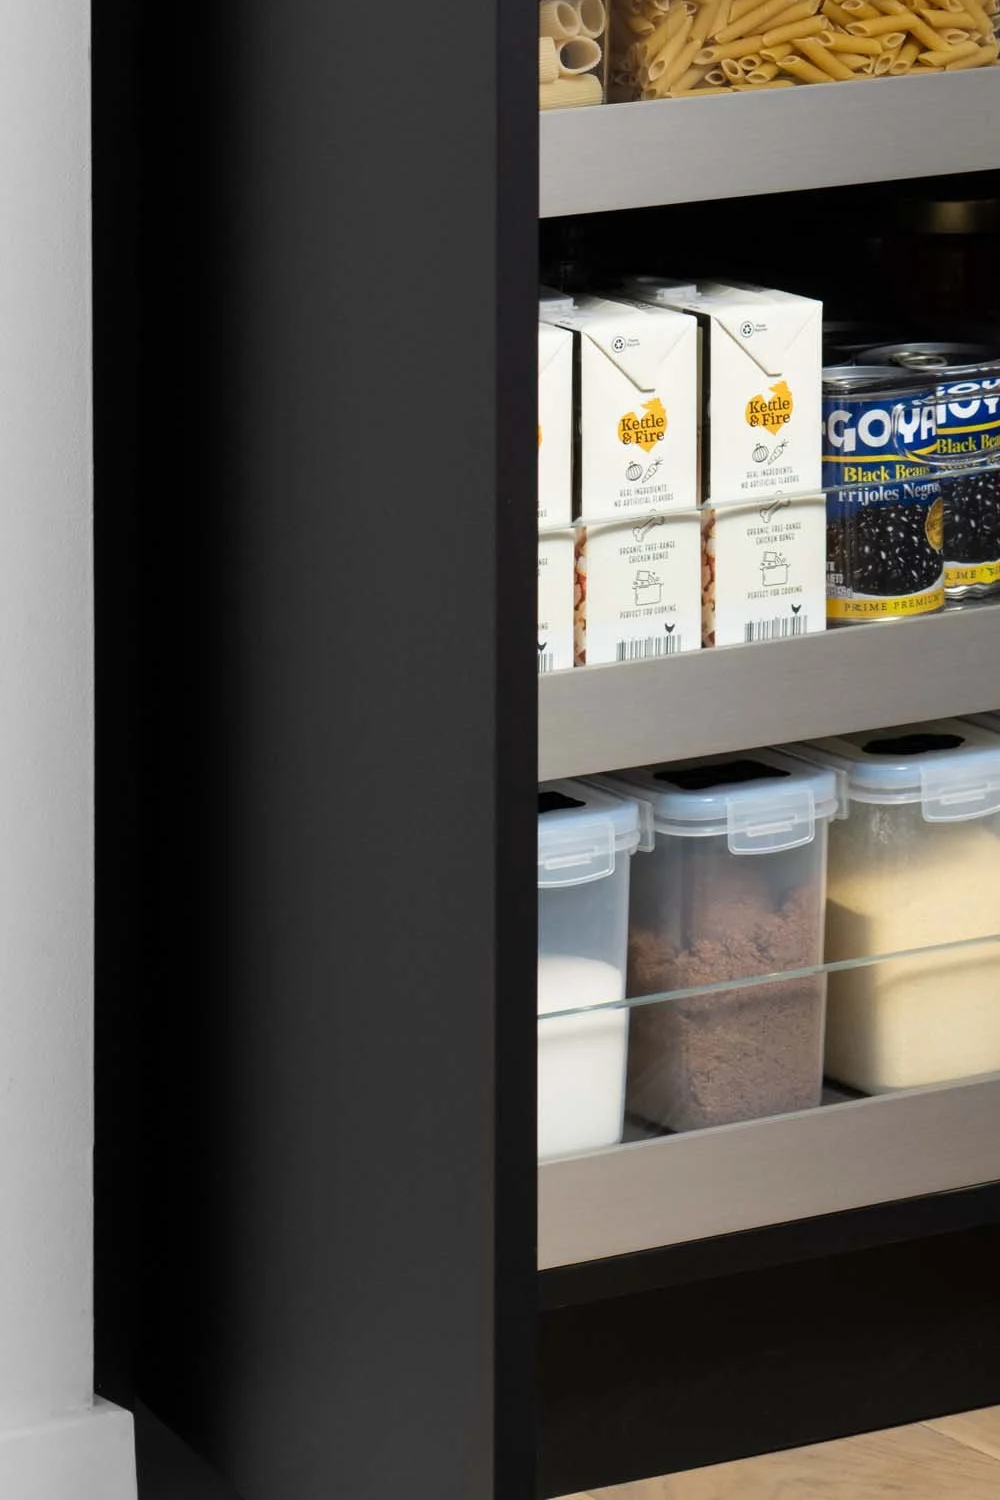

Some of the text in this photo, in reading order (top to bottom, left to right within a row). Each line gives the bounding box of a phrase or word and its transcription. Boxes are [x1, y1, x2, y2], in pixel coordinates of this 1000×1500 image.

[749, 396, 791, 414] Kettle
[621, 414, 664, 431] Kettle
[750, 412, 791, 428] & Fire
[828, 404, 937, 452] GOYA
[622, 429, 665, 445] & Fire
[937, 438, 977, 454] Black
[843, 463, 931, 483] Black Beans
[741, 480, 749, 489] NO
[614, 500, 621, 508] NO
[755, 532, 795, 546] CHICKEN BONES
[628, 550, 669, 564] CHICKEN BONES
[747, 585, 803, 600] PERFECT FOR COOKING
[619, 603, 677, 619] PERFECT FOR COOKING
[844, 602, 888, 612] PRIME
